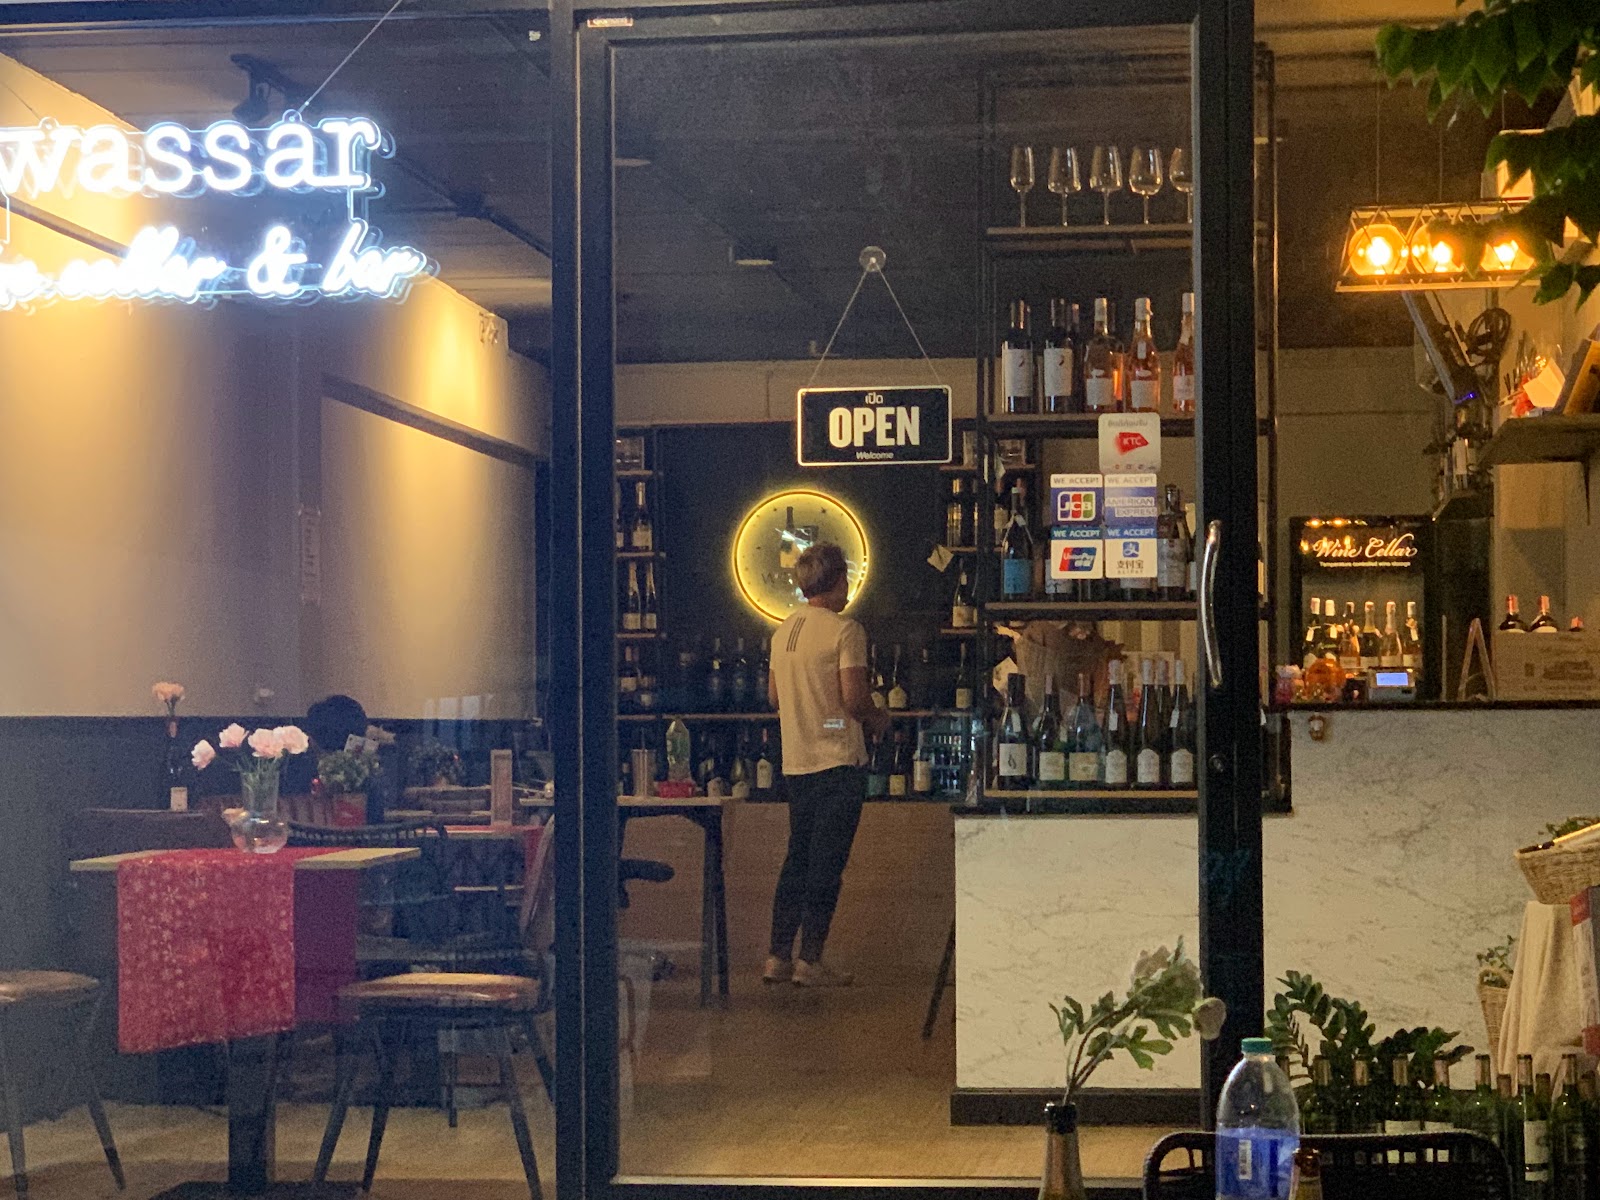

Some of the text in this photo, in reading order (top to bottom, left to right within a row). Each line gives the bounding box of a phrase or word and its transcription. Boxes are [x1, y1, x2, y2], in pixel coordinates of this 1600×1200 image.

[247, 225, 308, 298] &
[865, 392, 884, 404] เปิด
[829, 406, 920, 448] OPEN
[1123, 436, 1142, 446] KTC
[856, 452, 894, 460] Welcome
[1060, 501, 1093, 512] JCB
[1053, 529, 1100, 537] WE ACCEPT
[1107, 528, 1154, 537] WE ACCEPT
[1312, 533, 1418, 558] Wine Cellar
